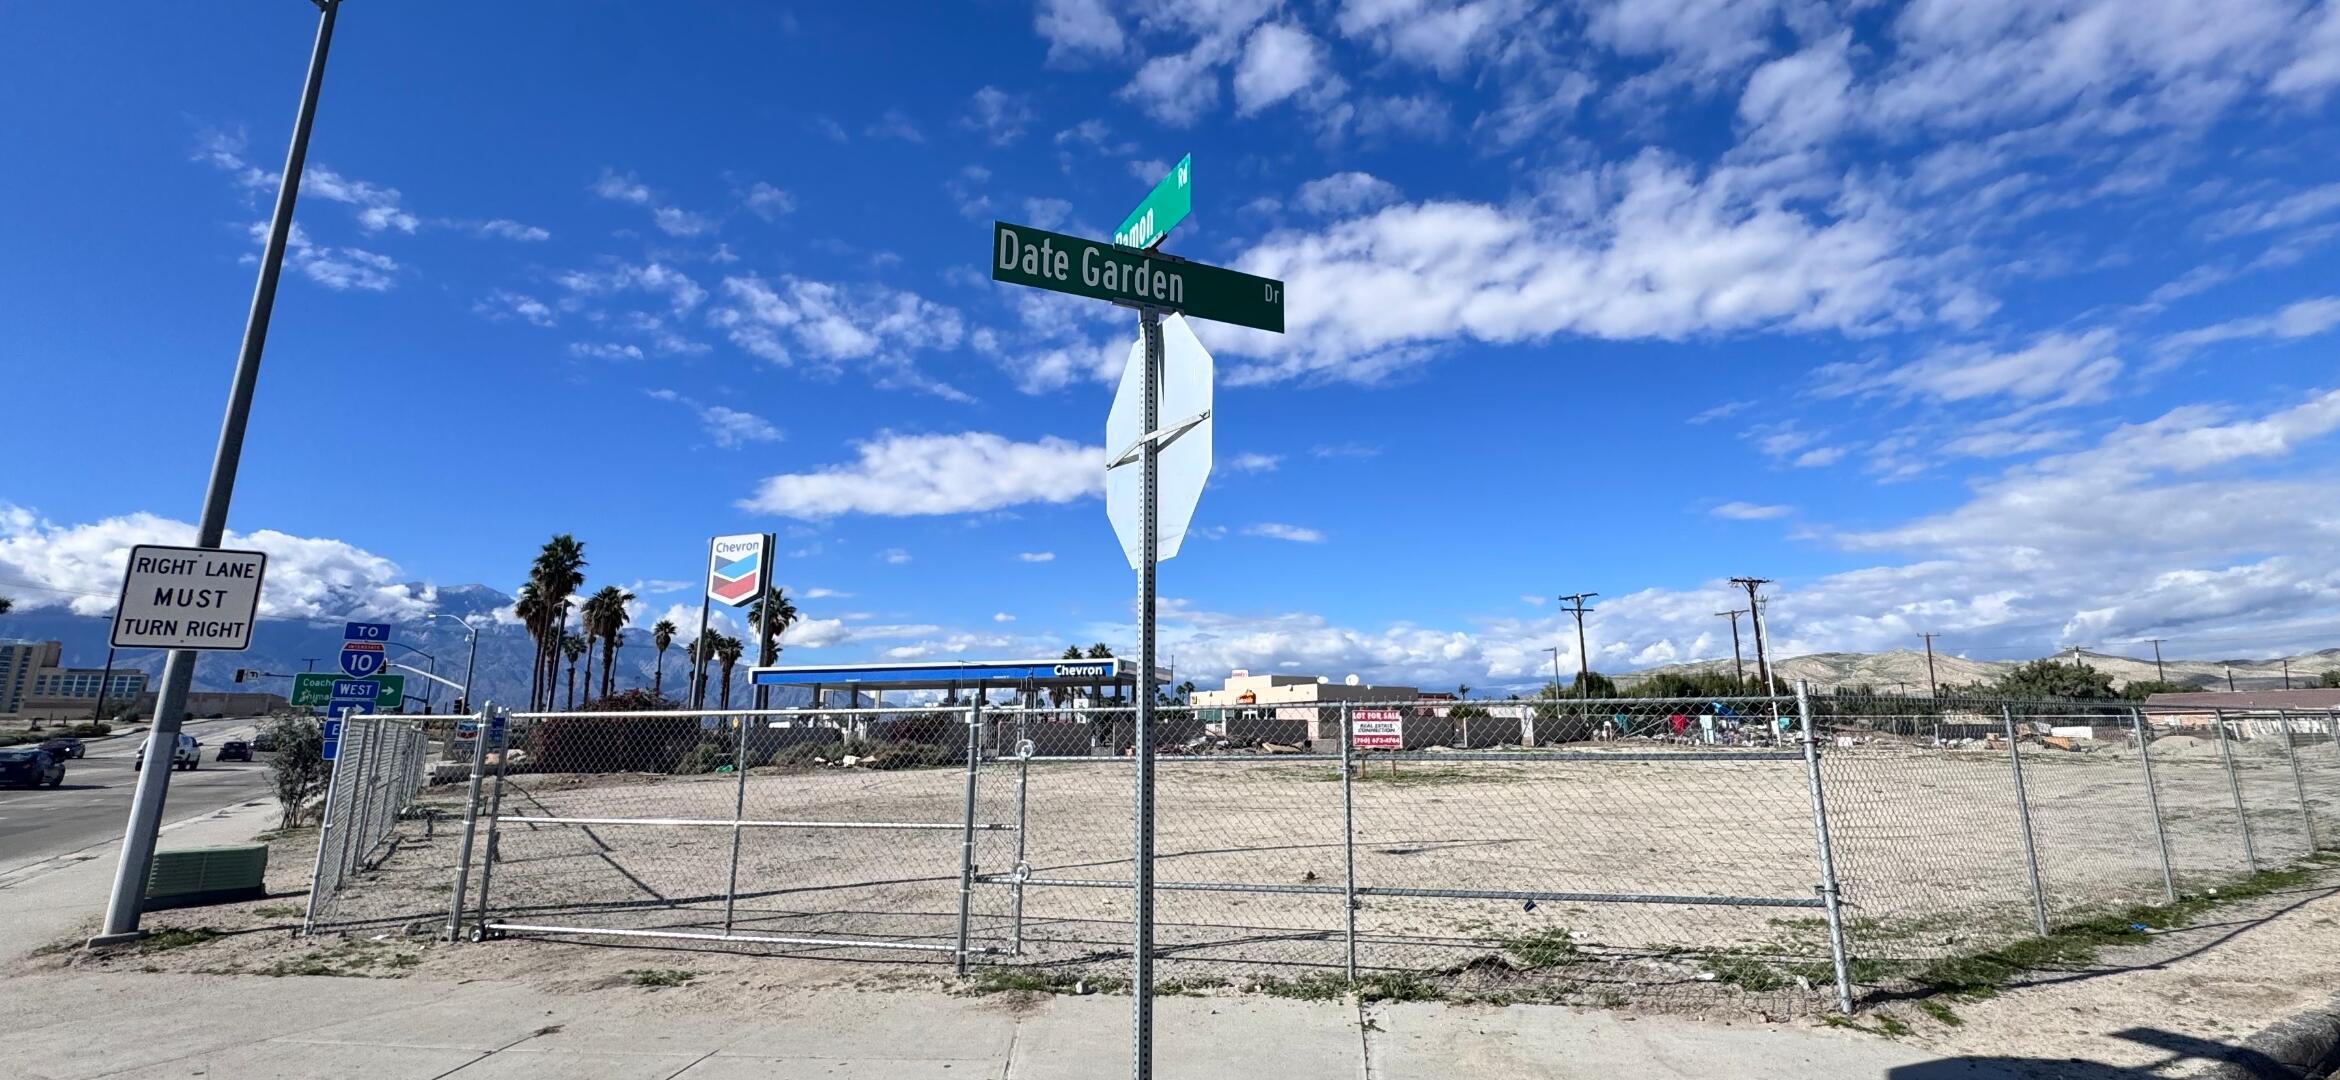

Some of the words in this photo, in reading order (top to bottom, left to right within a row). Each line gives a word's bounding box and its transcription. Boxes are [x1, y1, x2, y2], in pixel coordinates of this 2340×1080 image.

[1178, 162, 1188, 190] Rd
[999, 228, 1069, 281] Date
[1081, 247, 1184, 303] Garden
[1264, 283, 1280, 303] Dr
[716, 542, 759, 553] Chevron
[137, 557, 197, 575] RIGHT
[205, 561, 256, 579] LANE
[154, 587, 227, 608] MUST
[125, 618, 178, 636] TURN
[186, 621, 244, 638] RIGHT
[357, 626, 379, 637] TO
[350, 654, 372, 671] 10
[1053, 665, 1103, 676] Chevron
[340, 683, 373, 695] WEST
[1367, 712, 1381, 720] FOR
[1383, 712, 1399, 720] SALE
